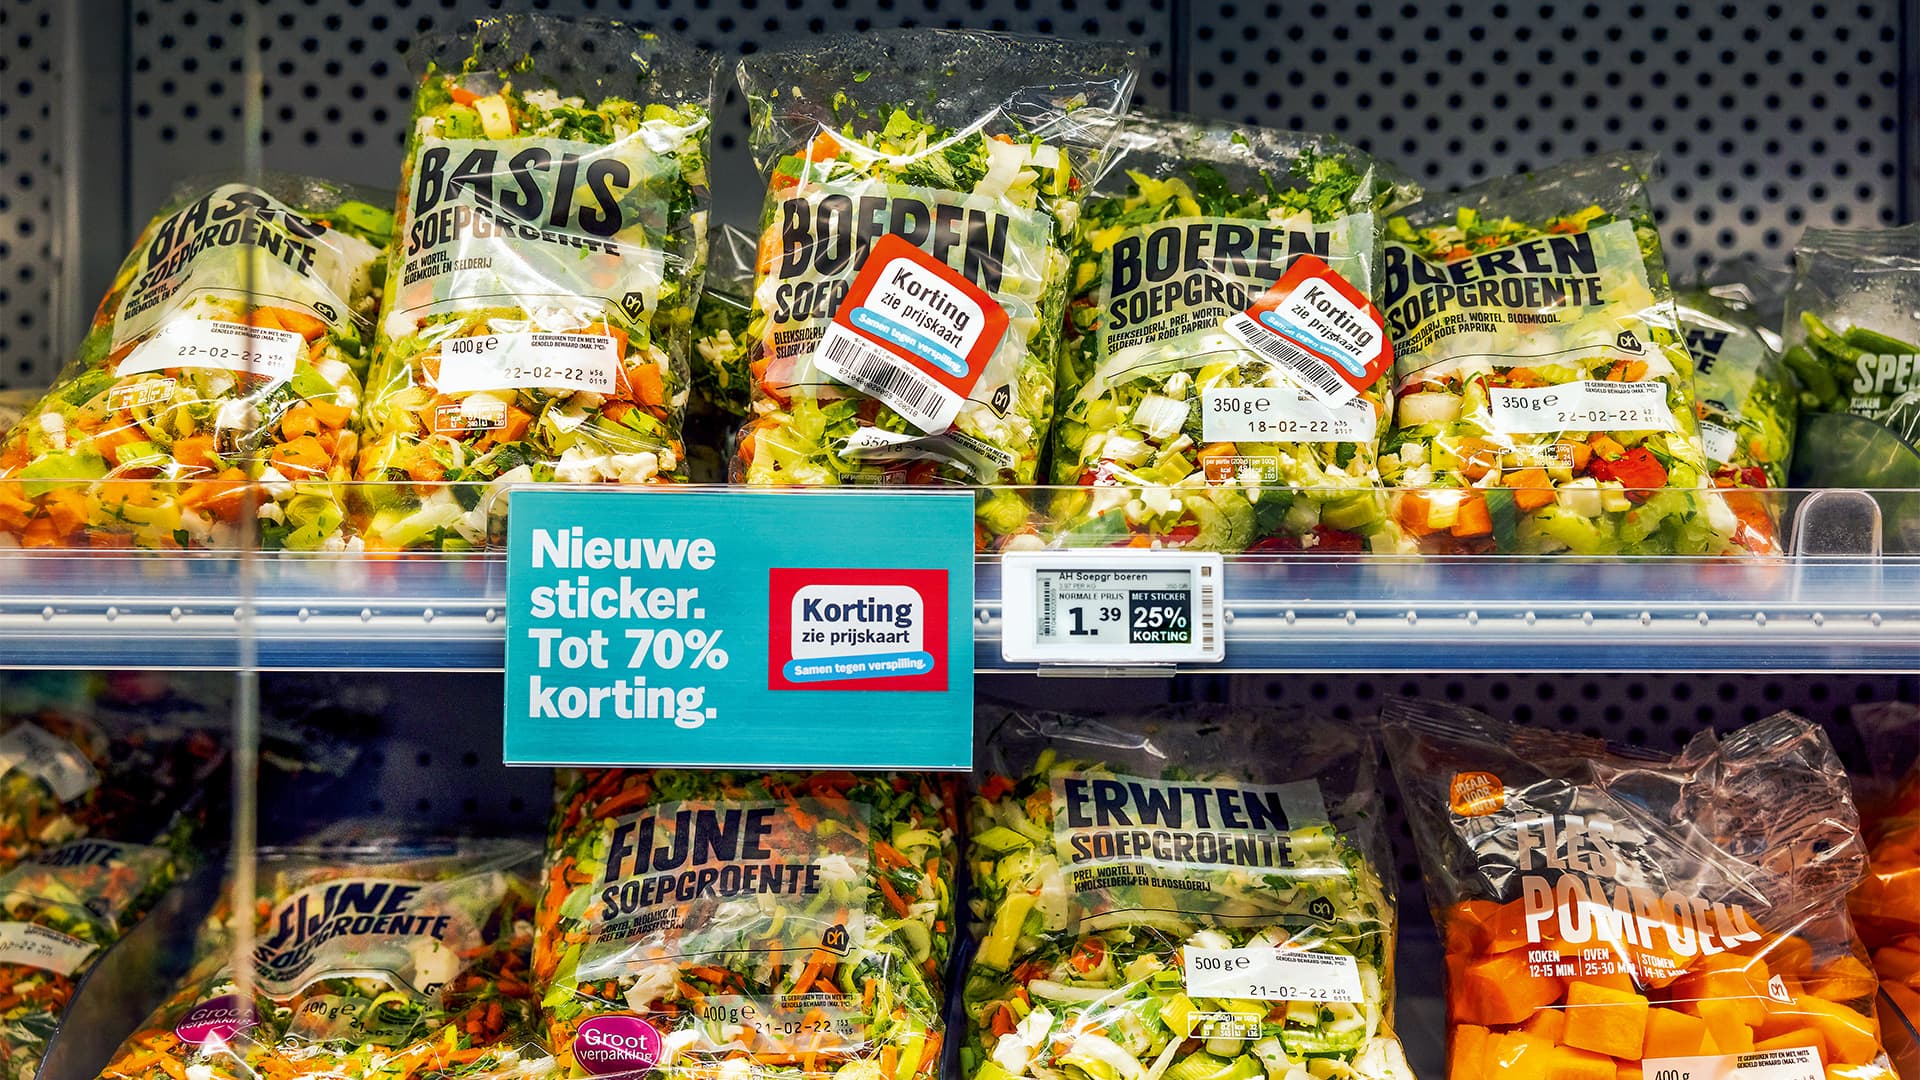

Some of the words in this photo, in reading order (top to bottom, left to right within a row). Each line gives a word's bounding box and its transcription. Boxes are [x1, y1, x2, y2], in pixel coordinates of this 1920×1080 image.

[415, 147, 630, 236] BASIS
[133, 218, 317, 297] SOEPGROENTE
[421, 250, 450, 267] WORTEL,
[1110, 223, 1330, 298] BOEREN
[403, 265, 440, 286] BLOEMKOOL
[443, 261, 452, 273] EN
[454, 257, 492, 271] SELDERIJ
[1385, 231, 1598, 308] BOEREN
[891, 267, 970, 332] Korting
[1192, 307, 1228, 320] WORTEL,
[1304, 285, 1374, 347] Korting
[1391, 277, 1605, 341] SOEPGROENTE
[1469, 312, 1505, 323] WORTEL,
[880, 290, 900, 309] zie
[902, 305, 963, 349] prijskaart
[1108, 337, 1143, 355] SELDERIJ
[1145, 335, 1155, 344] EN
[1158, 328, 1179, 341] RODE
[1181, 317, 1218, 334] PAPRIKA
[1291, 304, 1310, 320] zie
[1308, 316, 1363, 356] prijskaart
[1424, 338, 1433, 347] EN
[1434, 325, 1456, 340] RODE
[1459, 322, 1497, 333] PAPRIKA
[452, 340, 474, 354] 400
[858, 313, 890, 335] Samen
[892, 325, 916, 347] tegen
[918, 340, 962, 373] verspilling.
[178, 345, 262, 363] 22-02-22
[504, 367, 583, 381] 22-02-22
[1213, 398, 1240, 412] 350
[1502, 396, 1529, 410] 350
[1558, 410, 1638, 424] 22-02-22
[1248, 420, 1329, 433] 18-02-22
[532, 526, 716, 570] Nieuwe
[1059, 572, 1073, 580] AH
[1076, 572, 1111, 582] Soepgr
[1114, 572, 1148, 580] boeren
[530, 575, 706, 619] sticker.
[802, 598, 913, 628] Korting
[1133, 606, 1187, 628] 25%
[802, 629, 825, 643] zie
[830, 629, 910, 645] prijskaart
[1133, 631, 1188, 641] KORTING
[529, 628, 609, 668] Tot
[625, 629, 728, 669] 70%
[794, 663, 832, 676] Samen
[834, 661, 866, 675] tegen
[868, 657, 927, 672] verspilling.
[529, 676, 717, 729] korting.
[1455, 775, 1490, 793] IDEAAL
[1064, 778, 1290, 831] ERWTEN
[1463, 787, 1491, 804] VOOR
[1471, 798, 1497, 815] OVEN
[605, 808, 775, 883] FIJNE
[1070, 830, 1295, 867] SOEPGROENTE
[1515, 813, 1618, 877] FLES
[601, 864, 820, 921] SOEPGROENTE
[1075, 877, 1137, 893] KNOLSELDERIJ
[1139, 877, 1149, 886] EN
[1151, 878, 1211, 892] BLADSELDERIJ
[266, 883, 421, 948] FIJNE
[1522, 873, 1761, 957] POMPOEN
[1195, 957, 1221, 970] 500
[1528, 950, 1560, 963] KOKEN
[1583, 948, 1609, 961] OVEN
[1641, 954, 1676, 969] STOMEN
[1529, 965, 1553, 978] 12-15
[1555, 964, 1577, 976] MIN.
[1585, 963, 1615, 976] 25-30
[1250, 984, 1327, 999] 21-02-22
[302, 1002, 327, 1015] 400
[703, 1006, 725, 1022] 400
[756, 1020, 831, 1034] 21-02-22
[585, 1028, 648, 1050] Groot
[579, 1049, 653, 1064] verpakking
[1769, 1052, 1779, 1060] TOT
[1654, 1070, 1679, 1080] 400
